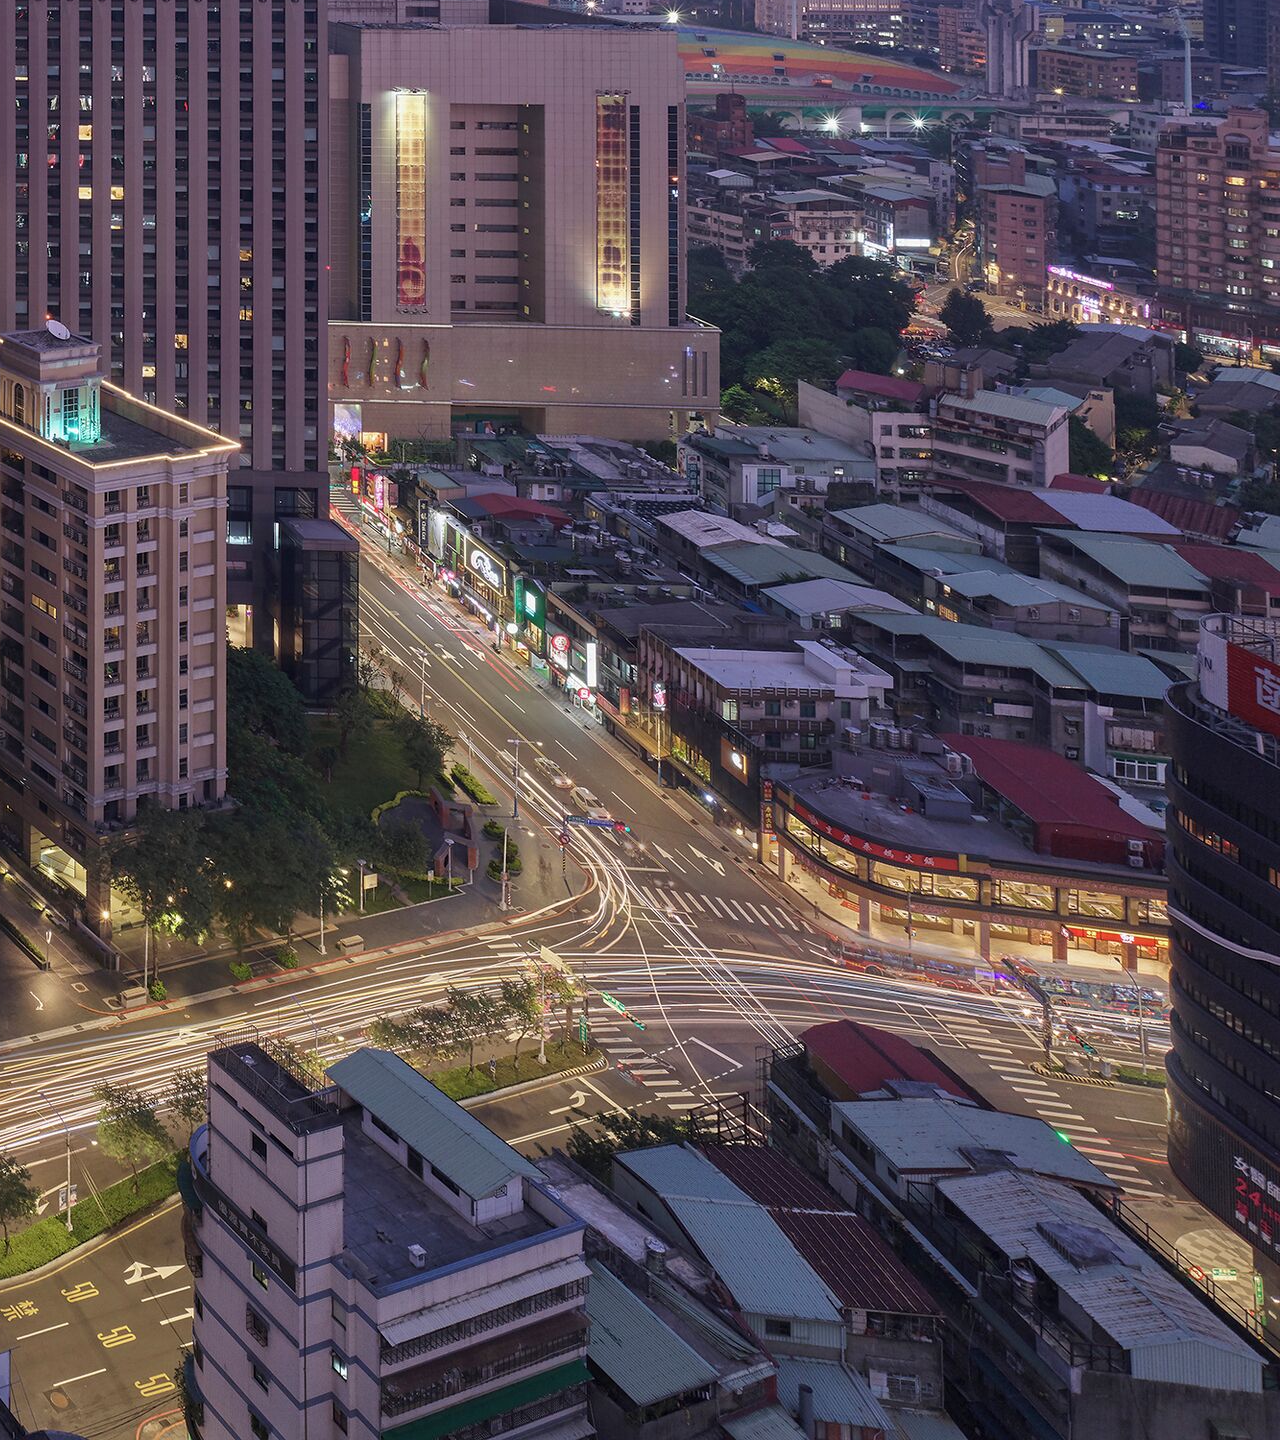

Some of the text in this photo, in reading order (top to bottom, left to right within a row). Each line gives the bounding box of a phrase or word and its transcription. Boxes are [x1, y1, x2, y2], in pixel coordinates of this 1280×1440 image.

[60, 1280, 100, 1304] 50
[97, 1324, 137, 1349] 50
[134, 1372, 176, 1398] 50
